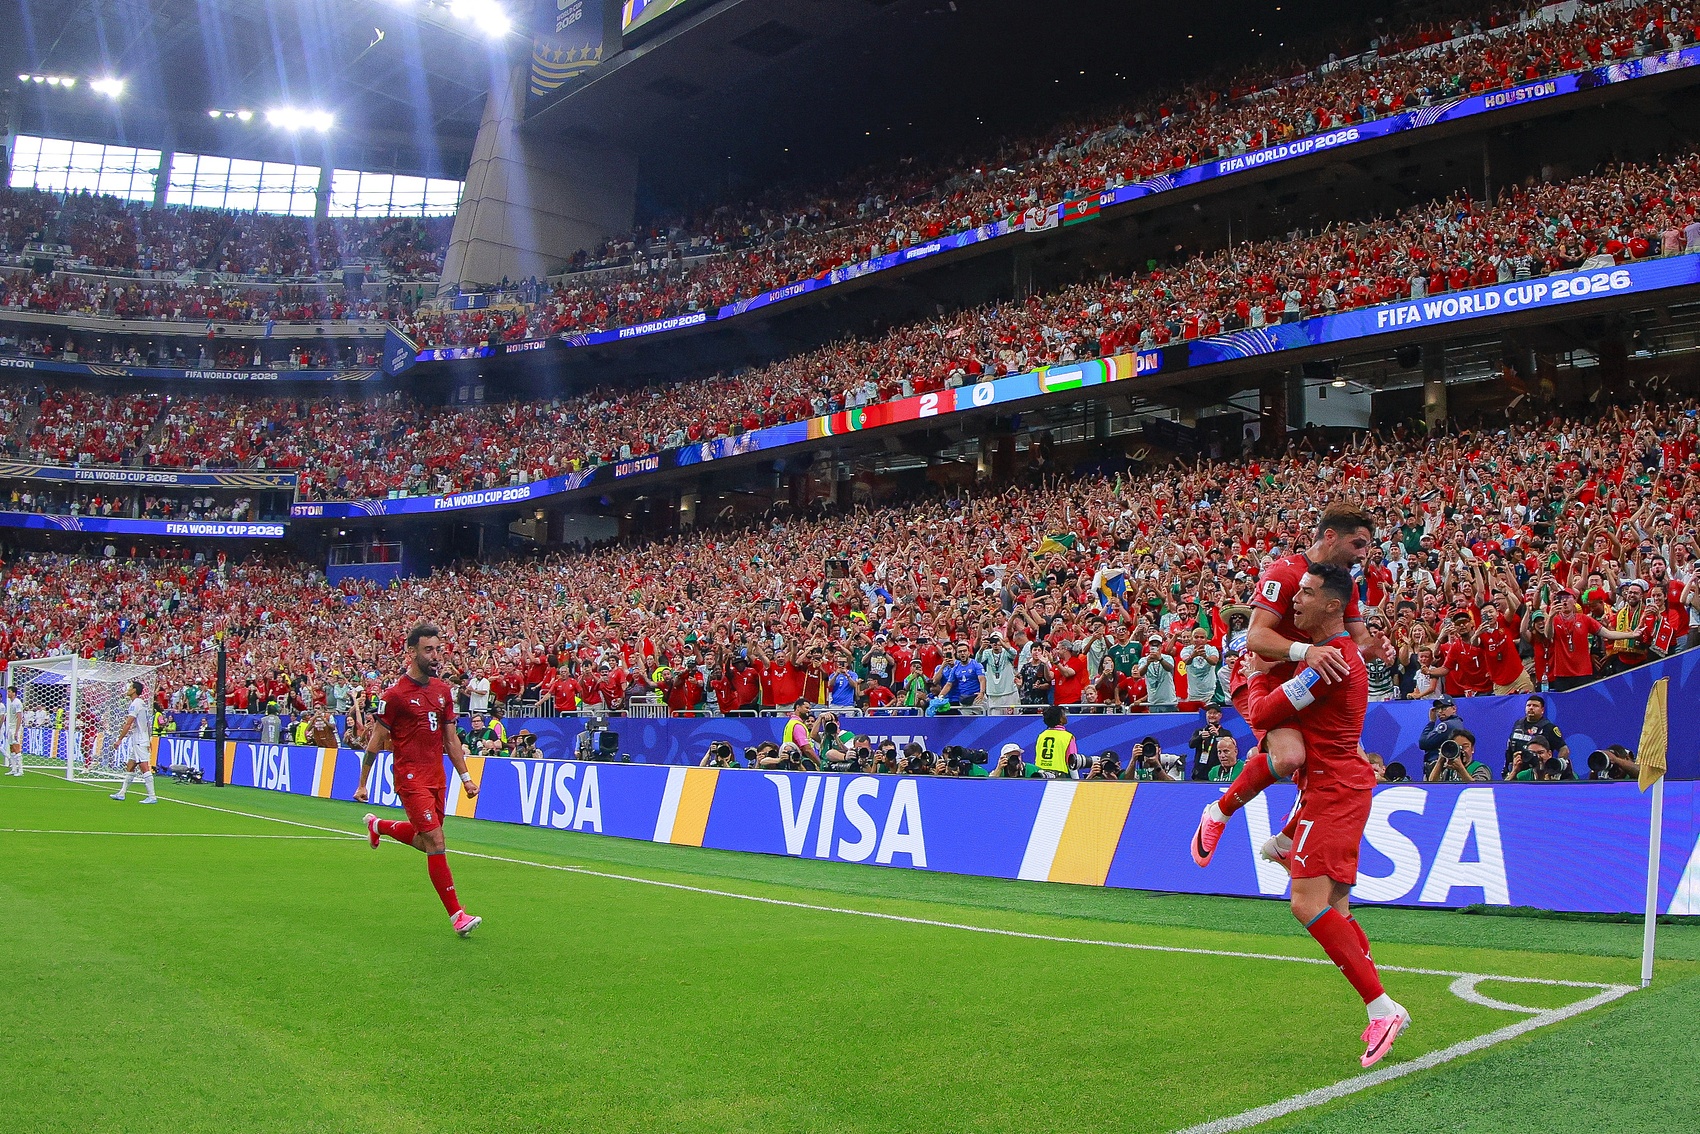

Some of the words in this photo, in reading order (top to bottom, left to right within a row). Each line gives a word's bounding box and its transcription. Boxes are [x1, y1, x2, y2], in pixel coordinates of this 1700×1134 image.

[556, 9, 582, 32] 2026
[1484, 81, 1556, 108] HOUSTON
[1220, 158, 1244, 173] FIFA
[1245, 146, 1287, 167] WORLD
[1289, 140, 1314, 155] CUP
[1315, 129, 1359, 149] 2026
[769, 282, 805, 302] HOUSTON
[1377, 306, 1422, 328] FIFA
[1423, 291, 1501, 320] WORLD
[1503, 282, 1548, 305] CUP
[1551, 269, 1631, 300] 2026
[619, 327, 635, 338] FIFA
[635, 322, 662, 336] WORLD
[662, 319, 678, 330] CUP
[678, 314, 706, 326] 2026
[506, 340, 546, 353] HOUSTON
[0, 359, 34, 369] STON
[185, 370, 202, 379] FIFA
[203, 371, 232, 380] WORLD
[233, 372, 249, 380] CUP
[250, 372, 278, 380] 2026
[919, 393, 939, 418] 2
[972, 381, 995, 407] 0
[75, 470, 95, 480] FIFA
[95, 471, 127, 481] WORLD
[127, 472, 147, 482] CUP
[146, 473, 178, 483] 2026
[615, 456, 659, 477] HOUSTON
[434, 497, 453, 509] FIFA
[454, 494, 484, 507] WORLD
[485, 490, 502, 504] CUP
[502, 486, 531, 501] 2026
[166, 523, 188, 534] FIFA
[188, 524, 226, 535] WORLD
[226, 525, 247, 535] CUP
[247, 525, 284, 536] 2026
[168, 739, 200, 772] VISA
[868, 735, 926, 764] FA
[248, 744, 291, 792] VISA
[354, 751, 402, 806] VIS
[511, 761, 602, 832] VISA
[764, 774, 927, 867] VISA
[1219, 786, 1510, 905] VSA
[1299, 819, 1315, 853] 7
